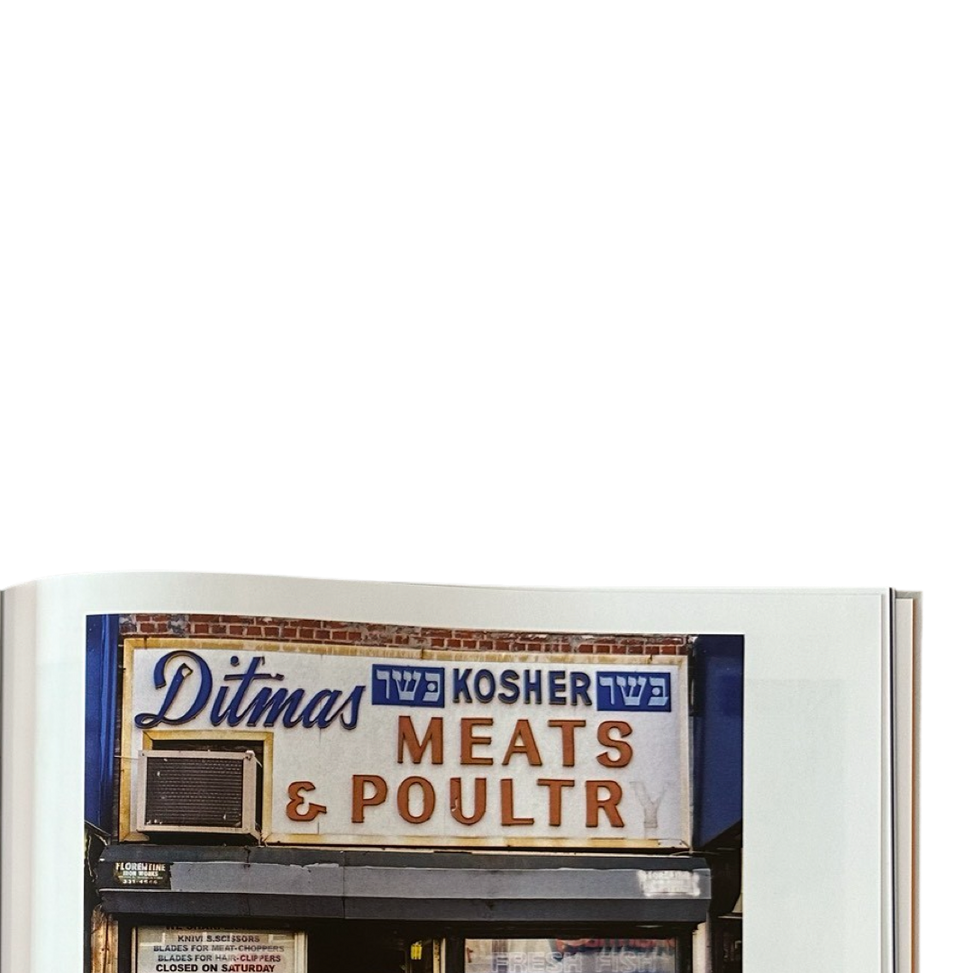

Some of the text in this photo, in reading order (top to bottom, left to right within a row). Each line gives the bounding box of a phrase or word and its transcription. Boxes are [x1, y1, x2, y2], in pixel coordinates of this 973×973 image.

[134, 650, 366, 730] Ditmas
[452, 668, 592, 706] KOSHER
[397, 715, 634, 768] MEATS
[286, 781, 327, 822] &
[156, 964, 276, 973] CLOSED ON SATURDAY
[158, 954, 193, 962] BLADES
[194, 954, 213, 962] FOR
[493, 952, 657, 973] FRESH FISH
